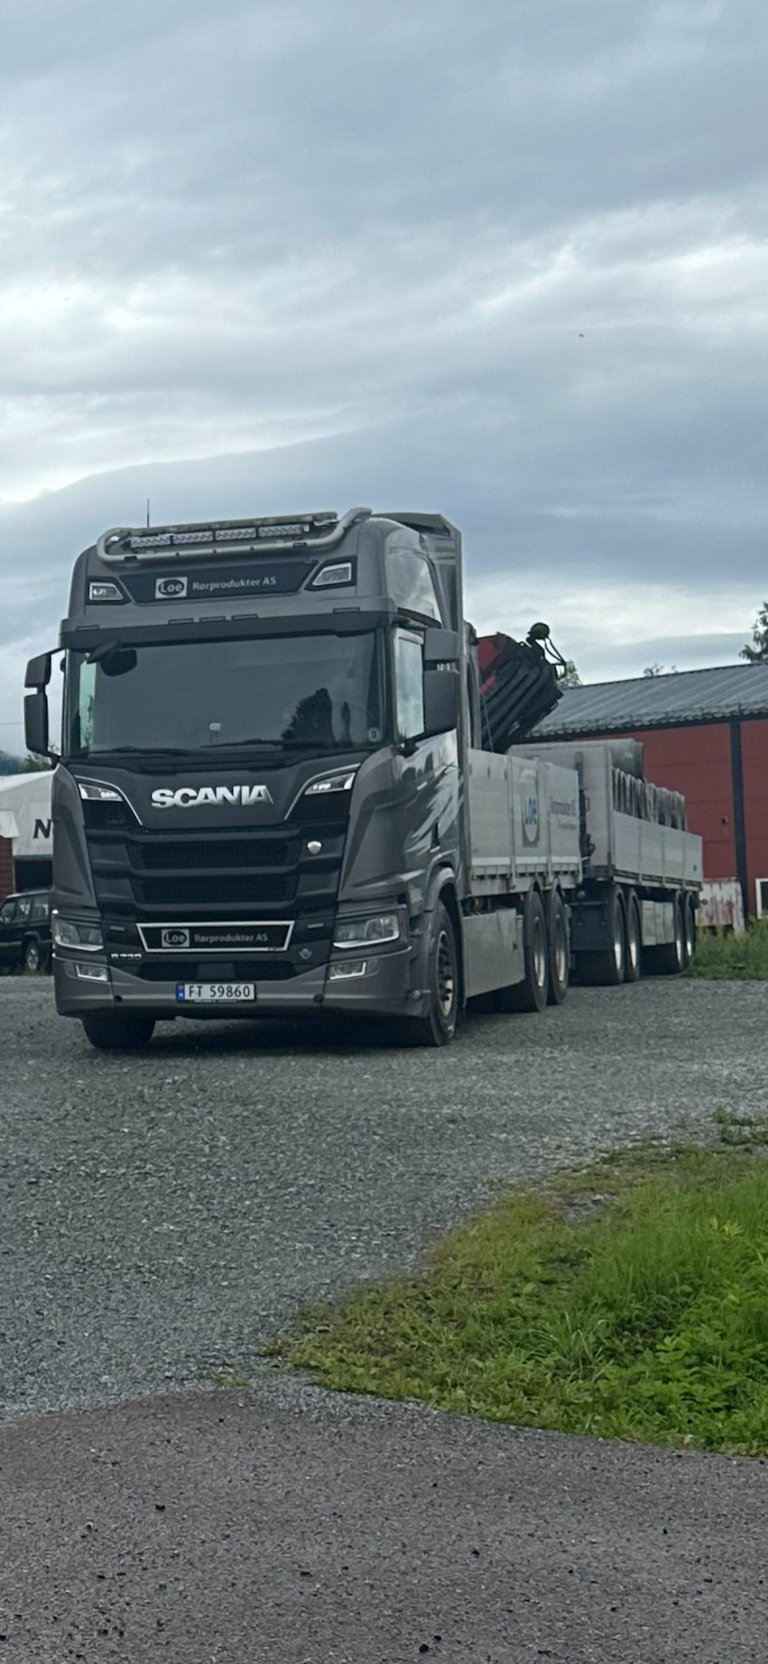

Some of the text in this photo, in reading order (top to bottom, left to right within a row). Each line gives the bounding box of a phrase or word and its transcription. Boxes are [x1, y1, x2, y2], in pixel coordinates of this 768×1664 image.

[262, 576, 277, 586] AS
[151, 785, 274, 808] SCANIA
[256, 931, 268, 942] AS
[188, 985, 251, 998] FT 59860
